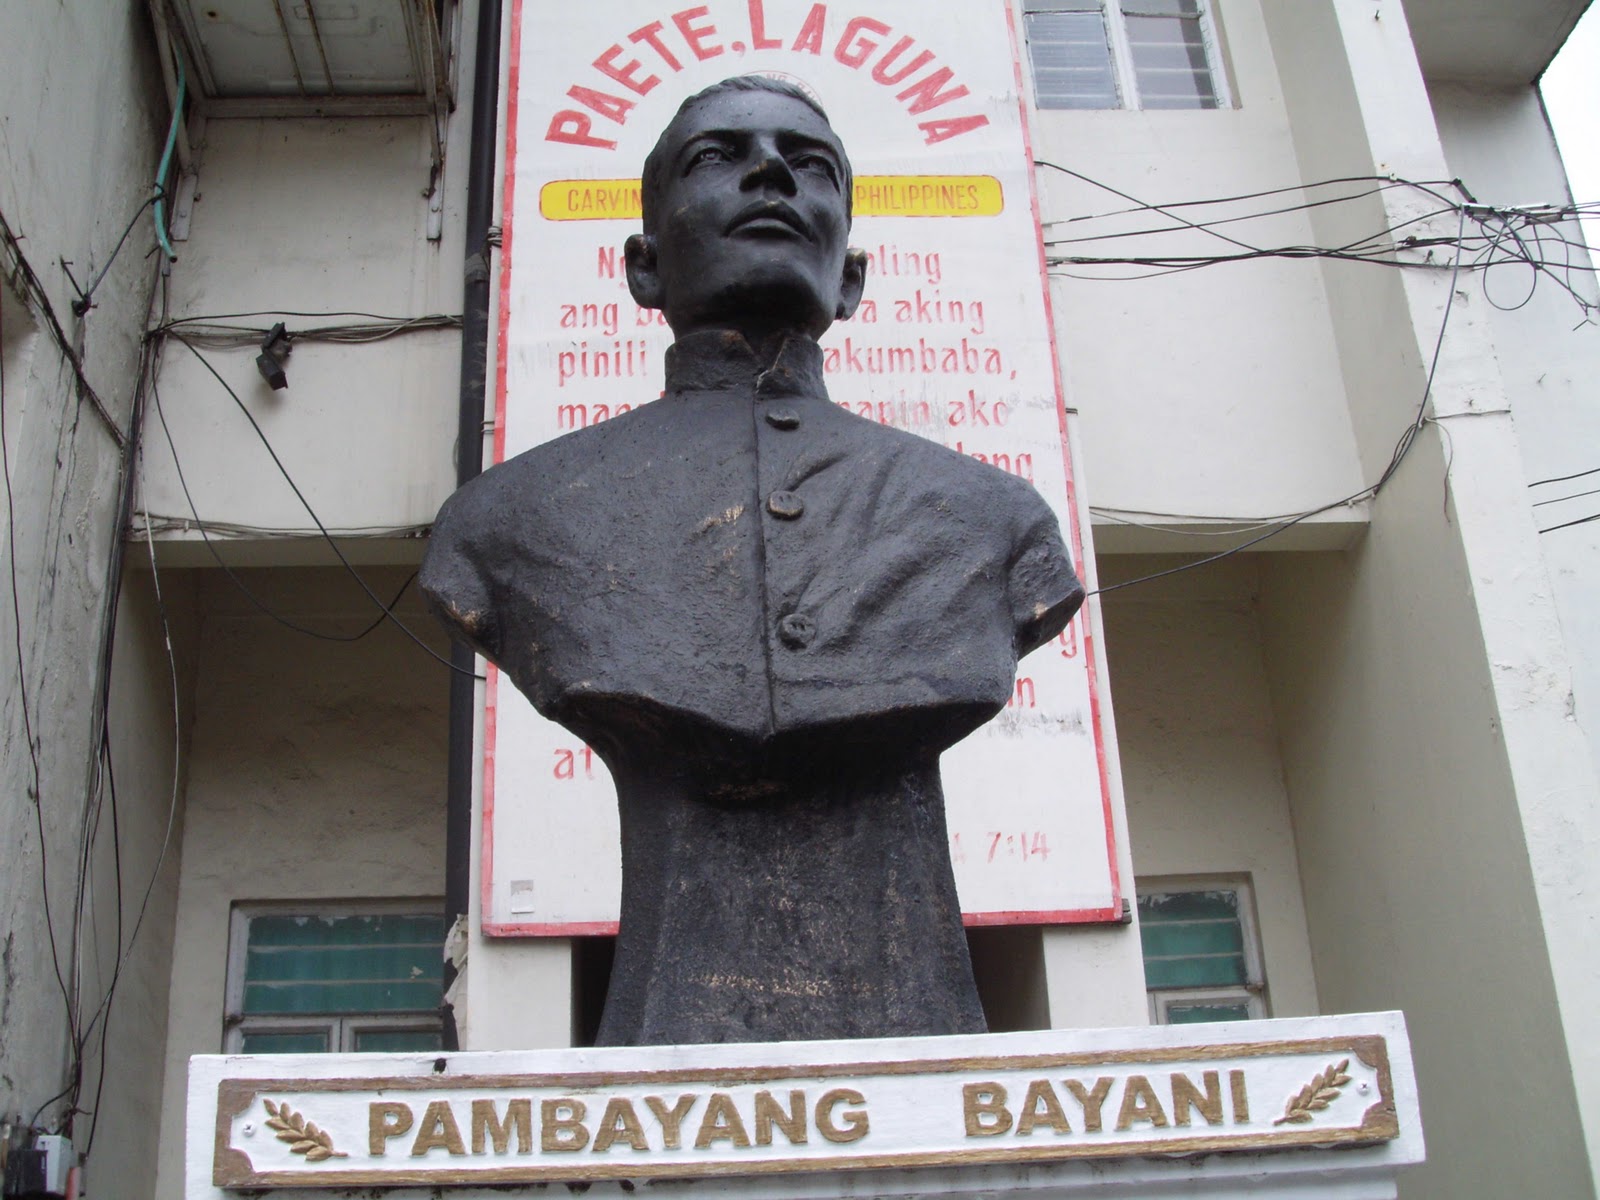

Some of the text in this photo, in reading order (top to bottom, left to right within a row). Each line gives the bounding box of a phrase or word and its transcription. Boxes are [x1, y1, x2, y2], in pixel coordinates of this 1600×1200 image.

[748, 0, 990, 146] LAGUNA
[567, 184, 979, 212] CARVIN PHILIPPINES
[560, 303, 618, 336] ang
[894, 288, 984, 335] aking
[558, 340, 647, 387] pinili
[823, 337, 1017, 380] akumbaba,
[948, 389, 1008, 427] ako
[985, 831, 1051, 863] 7:14
[368, 1069, 1251, 1156] PAMBAYANG BAYANI
